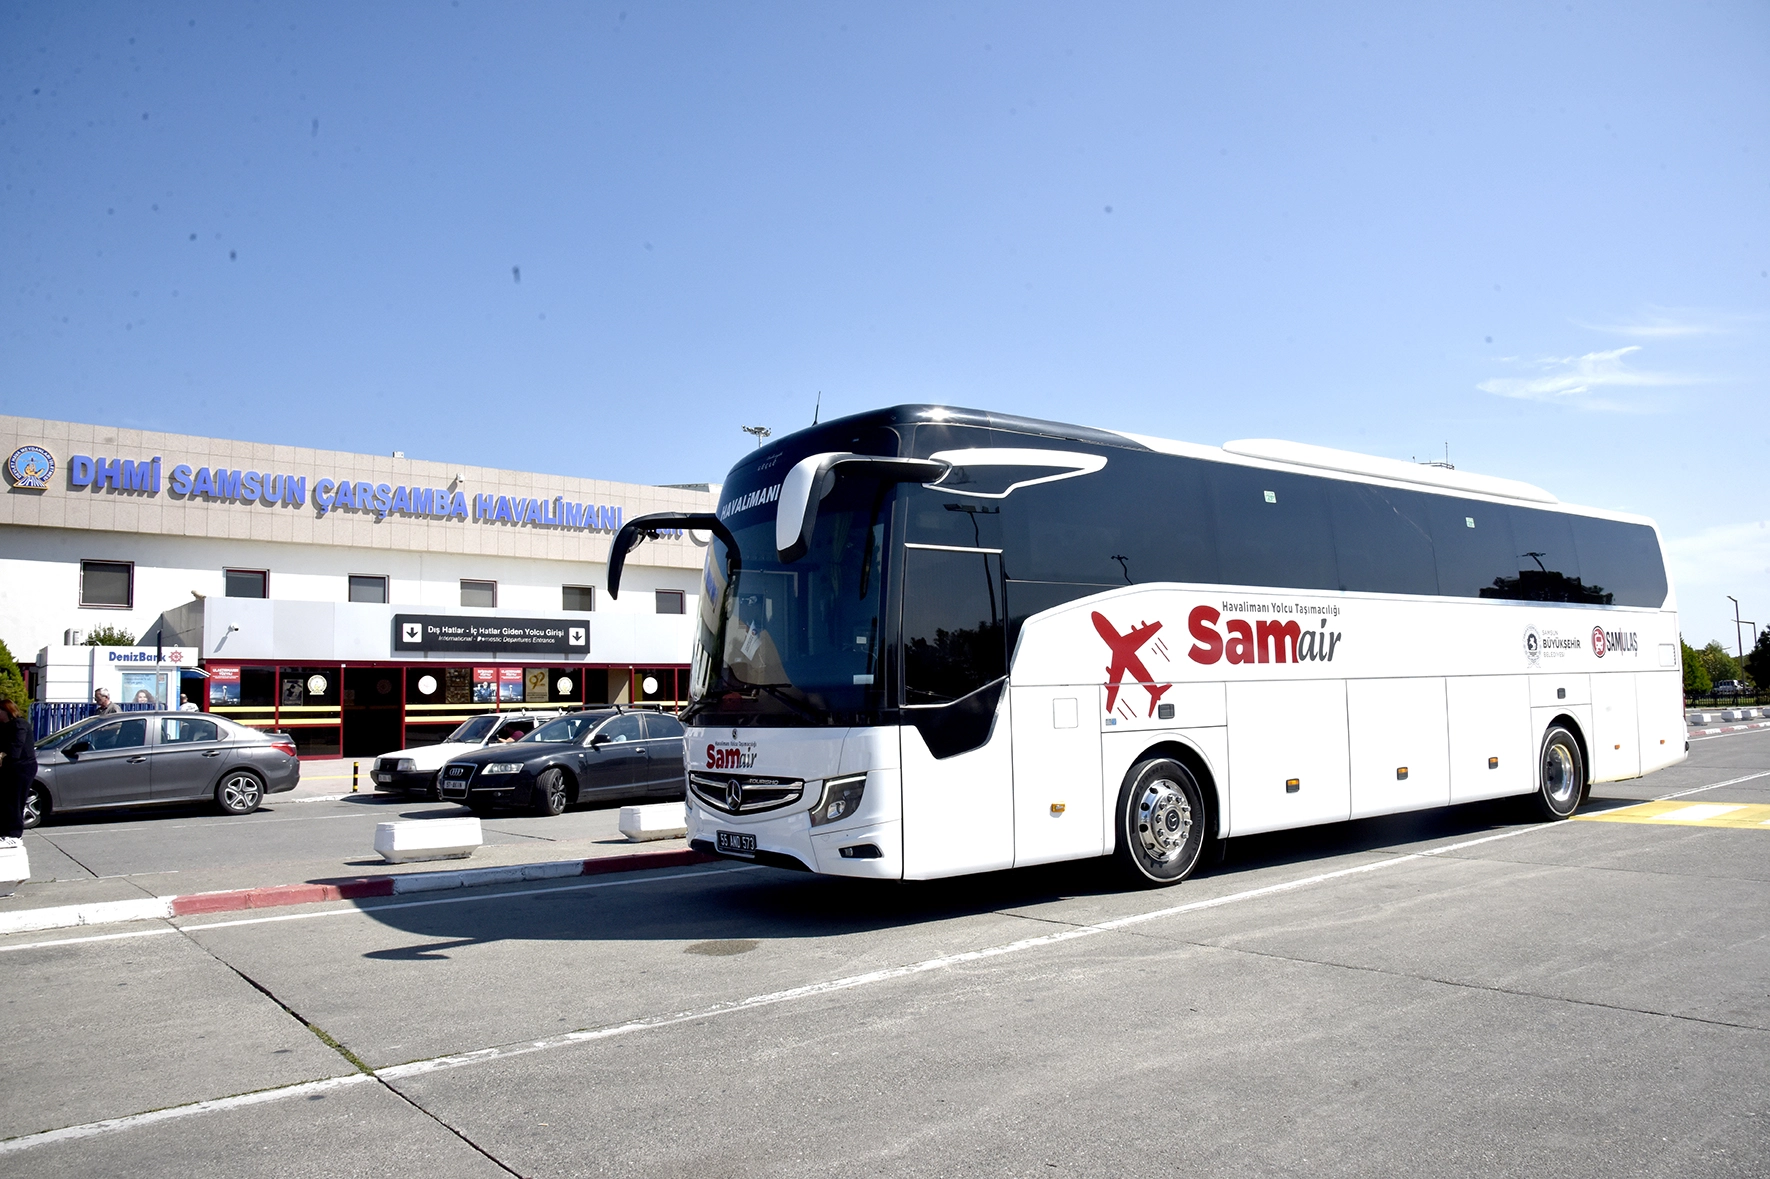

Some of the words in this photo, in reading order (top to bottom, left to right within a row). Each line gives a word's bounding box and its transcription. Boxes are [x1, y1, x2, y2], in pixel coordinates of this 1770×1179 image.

[72, 455, 161, 492] DHMİ
[173, 464, 306, 504] SAMSUN
[316, 478, 469, 518] ÇARŞAMBA
[477, 493, 623, 531] HAVALİMANI
[1222, 601, 1269, 613] Havalimanı
[1271, 602, 1293, 614] Yolcu
[1294, 603, 1340, 617] Taşımacılığı
[428, 626, 440, 635] Dış
[471, 625, 478, 636] İç
[525, 628, 544, 636] Yolcu
[546, 629, 564, 638] Girişi
[1543, 637, 1581, 650] BÜYÜKŞEHİR
[720, 833, 728, 846] 55
[742, 836, 755, 850] 573
